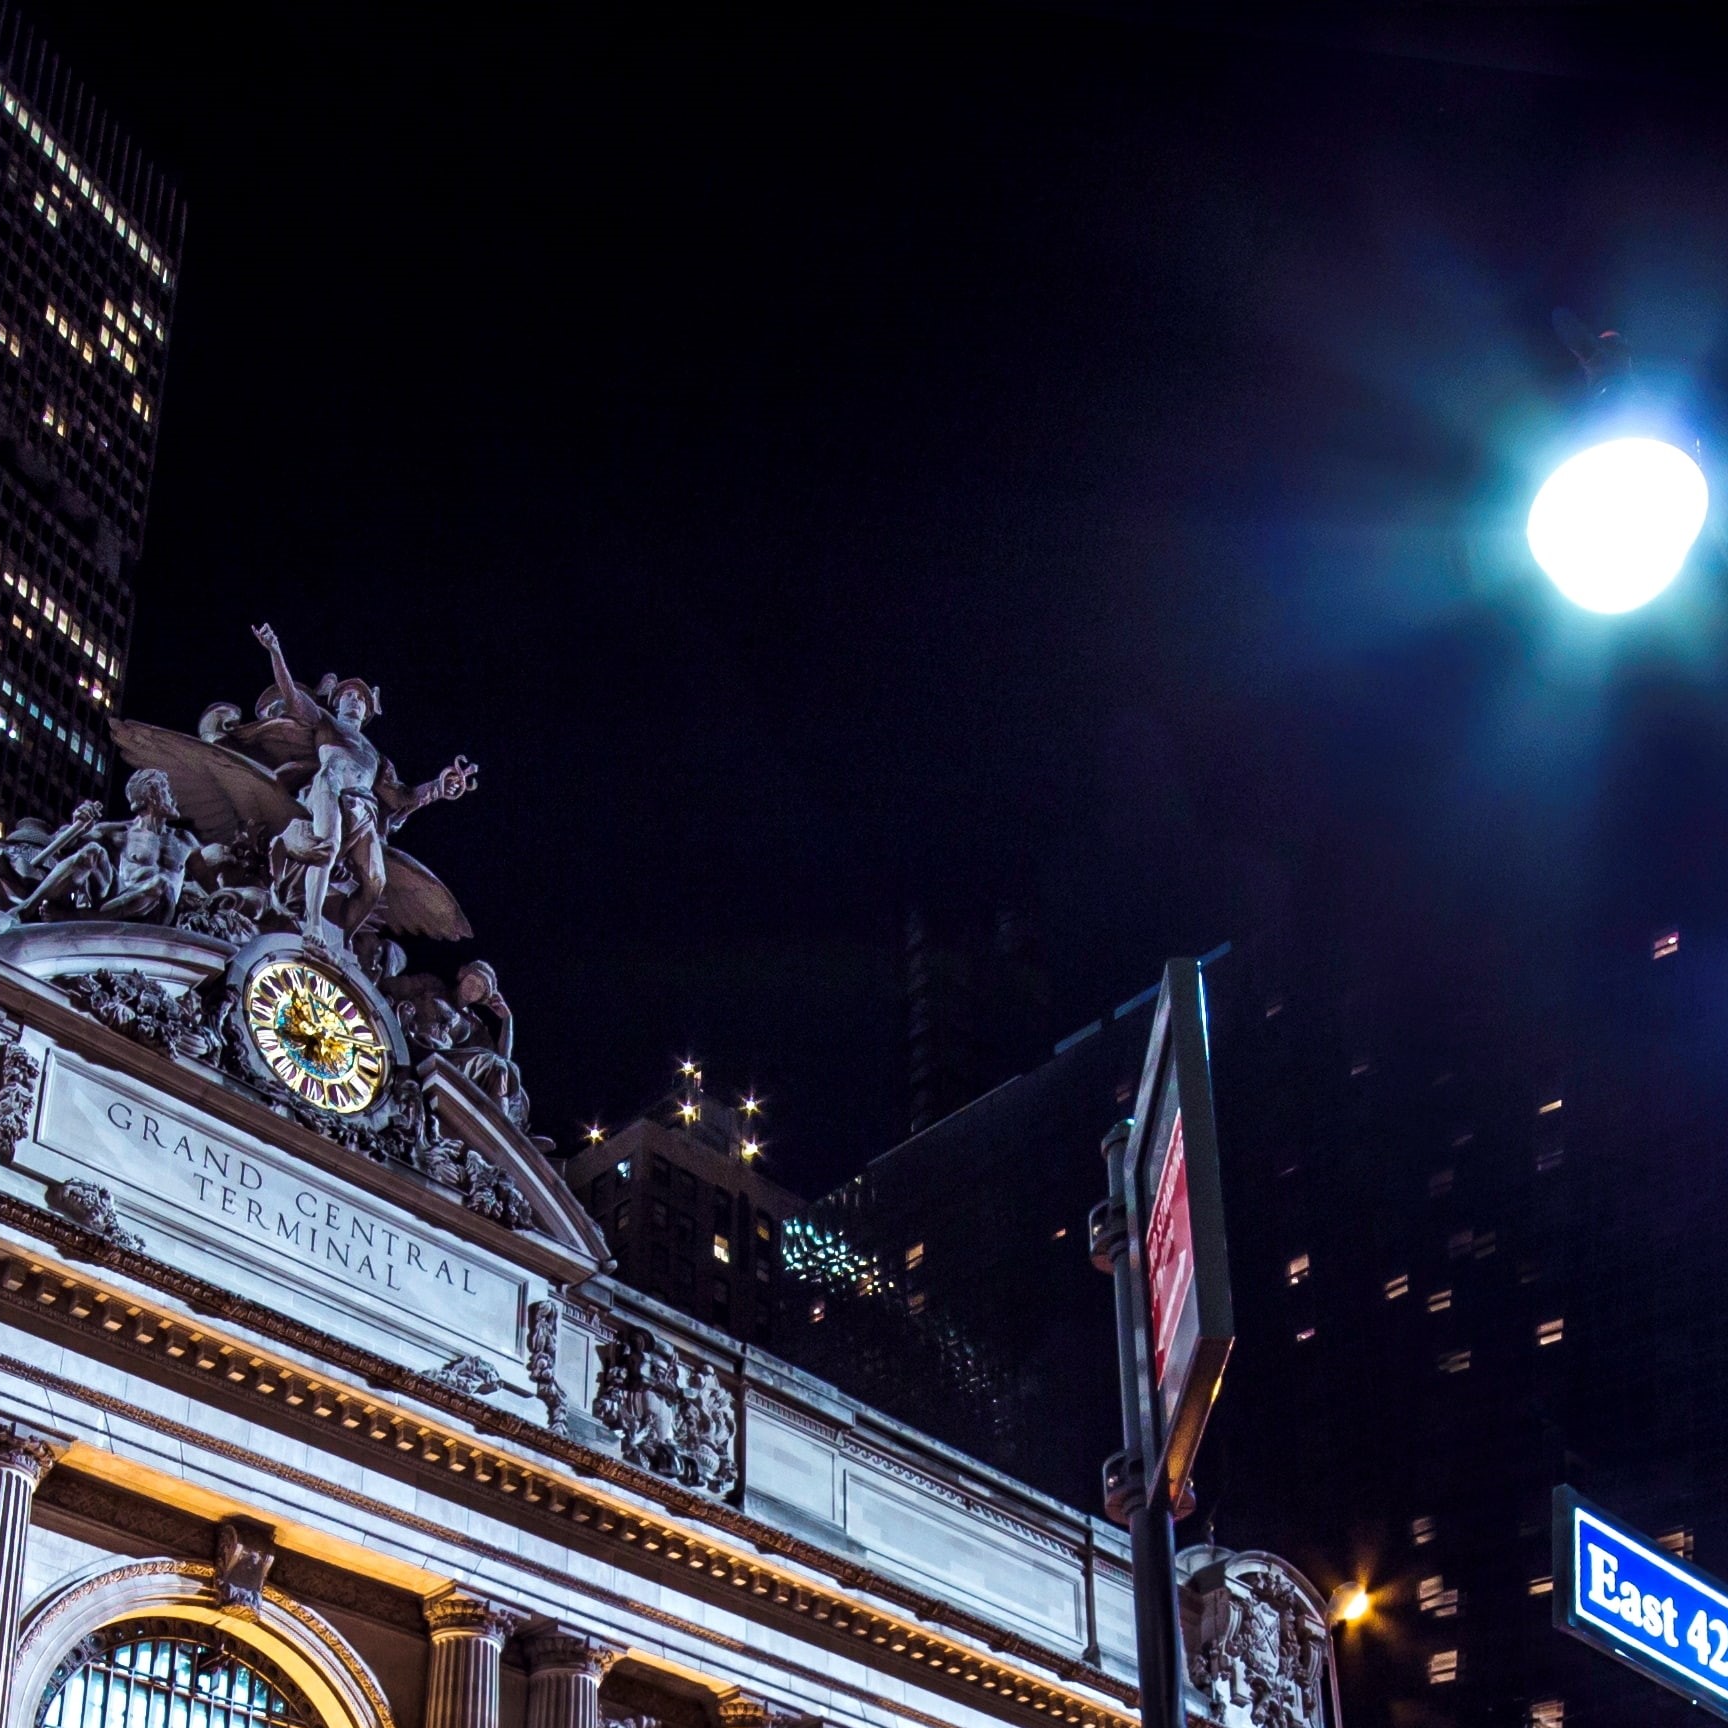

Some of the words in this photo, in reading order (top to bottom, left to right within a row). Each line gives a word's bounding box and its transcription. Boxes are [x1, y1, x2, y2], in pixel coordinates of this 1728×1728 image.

[107, 1101, 263, 1190] GRAND
[295, 1191, 477, 1296] CENTRAL
[193, 1172, 402, 1291] TERMINAL
[1587, 1542, 1679, 1648] East
